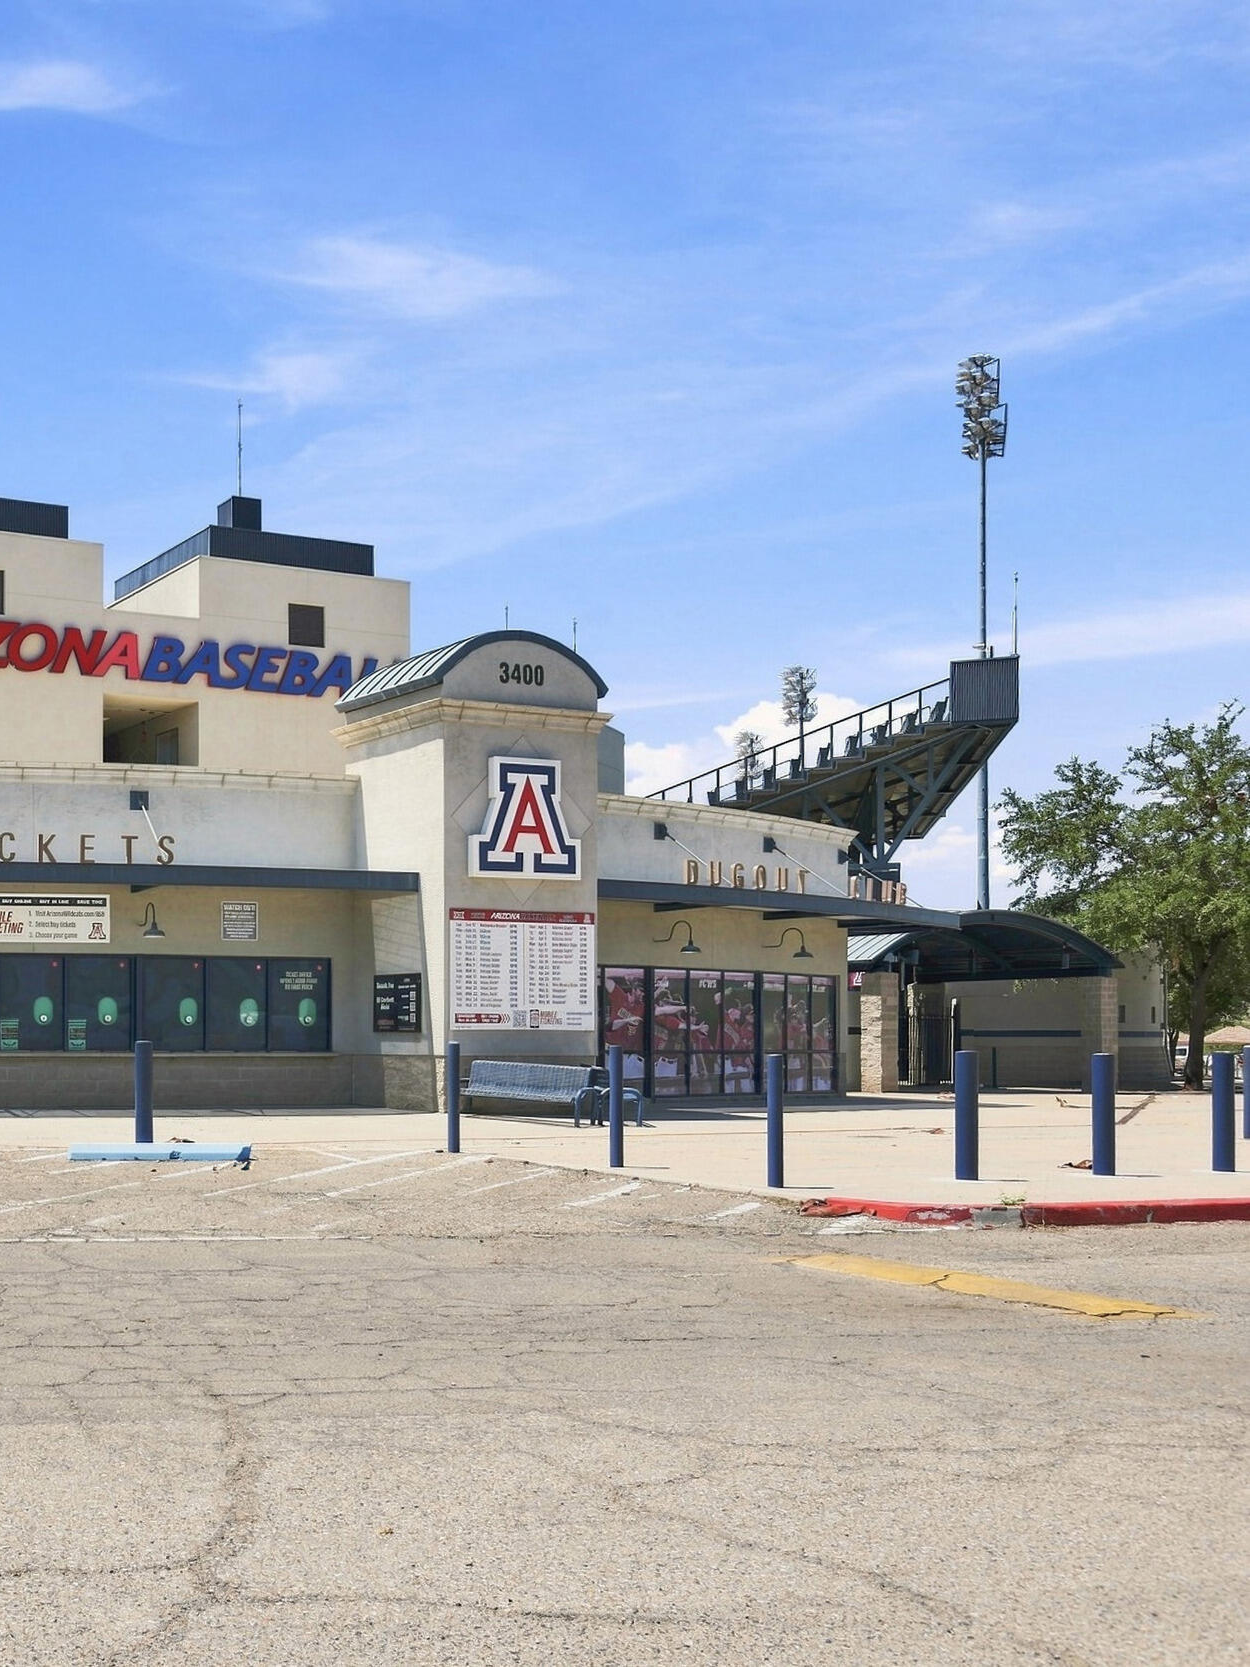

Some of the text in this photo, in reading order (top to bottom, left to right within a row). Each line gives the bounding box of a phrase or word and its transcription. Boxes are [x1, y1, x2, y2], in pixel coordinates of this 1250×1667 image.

[139, 636, 379, 698] BASEBA
[499, 662, 545, 686] 3400
[468, 756, 582, 880] A
[685, 859, 810, 895] DUGOUT
[88, 922, 106, 939] A
[490, 912, 521, 920] ARIZONA
